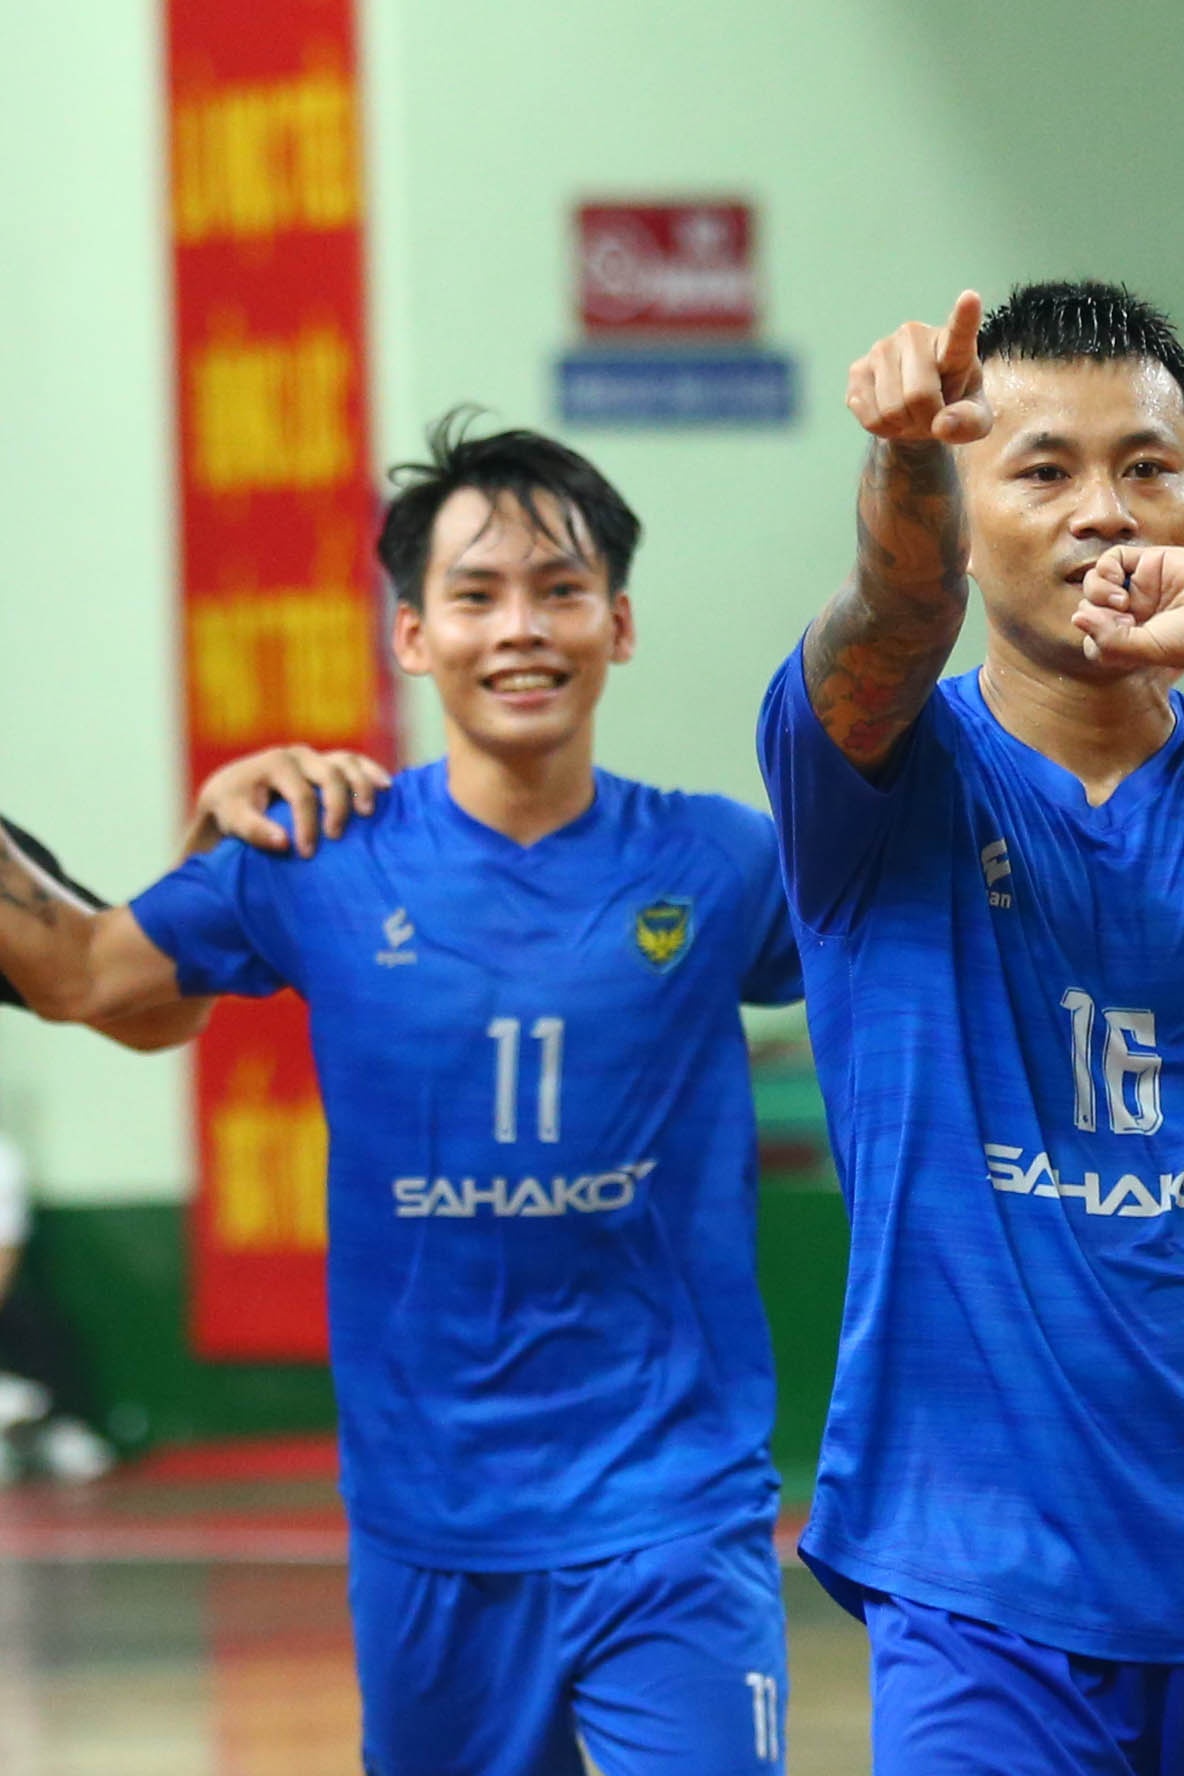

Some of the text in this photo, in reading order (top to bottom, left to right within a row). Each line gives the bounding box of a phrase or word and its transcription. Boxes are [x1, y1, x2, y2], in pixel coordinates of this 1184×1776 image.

[988, 891, 1011, 908] an
[486, 1017, 565, 1143] 11
[1060, 987, 1163, 1135] 16
[393, 1159, 658, 1218] SAHAKO
[745, 1672, 777, 1761] 11
